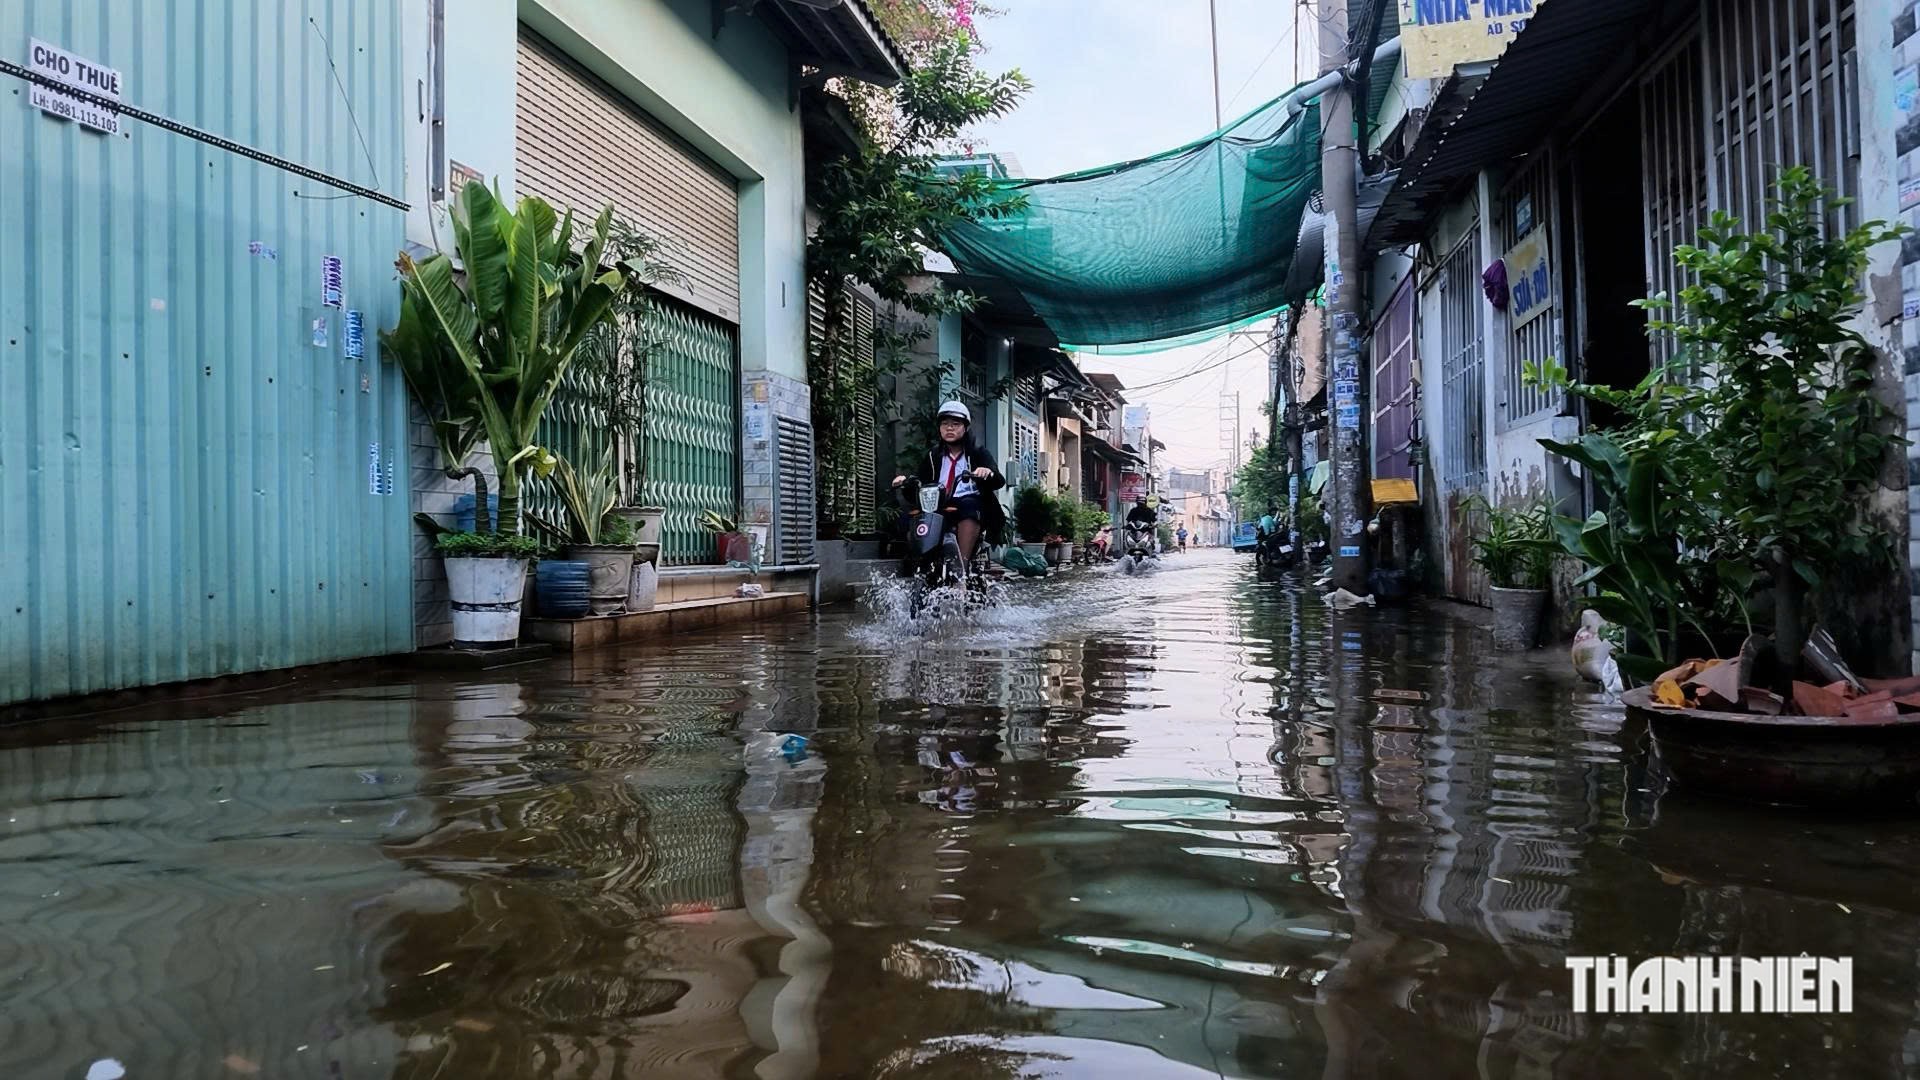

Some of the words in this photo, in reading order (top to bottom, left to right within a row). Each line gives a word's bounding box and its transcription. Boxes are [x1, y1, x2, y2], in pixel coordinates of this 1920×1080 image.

[34, 46, 70, 75] CHO
[75, 61, 119, 95] THUÊ
[33, 92, 49, 108] LH:
[52, 99, 118, 133] 0981.113.103
